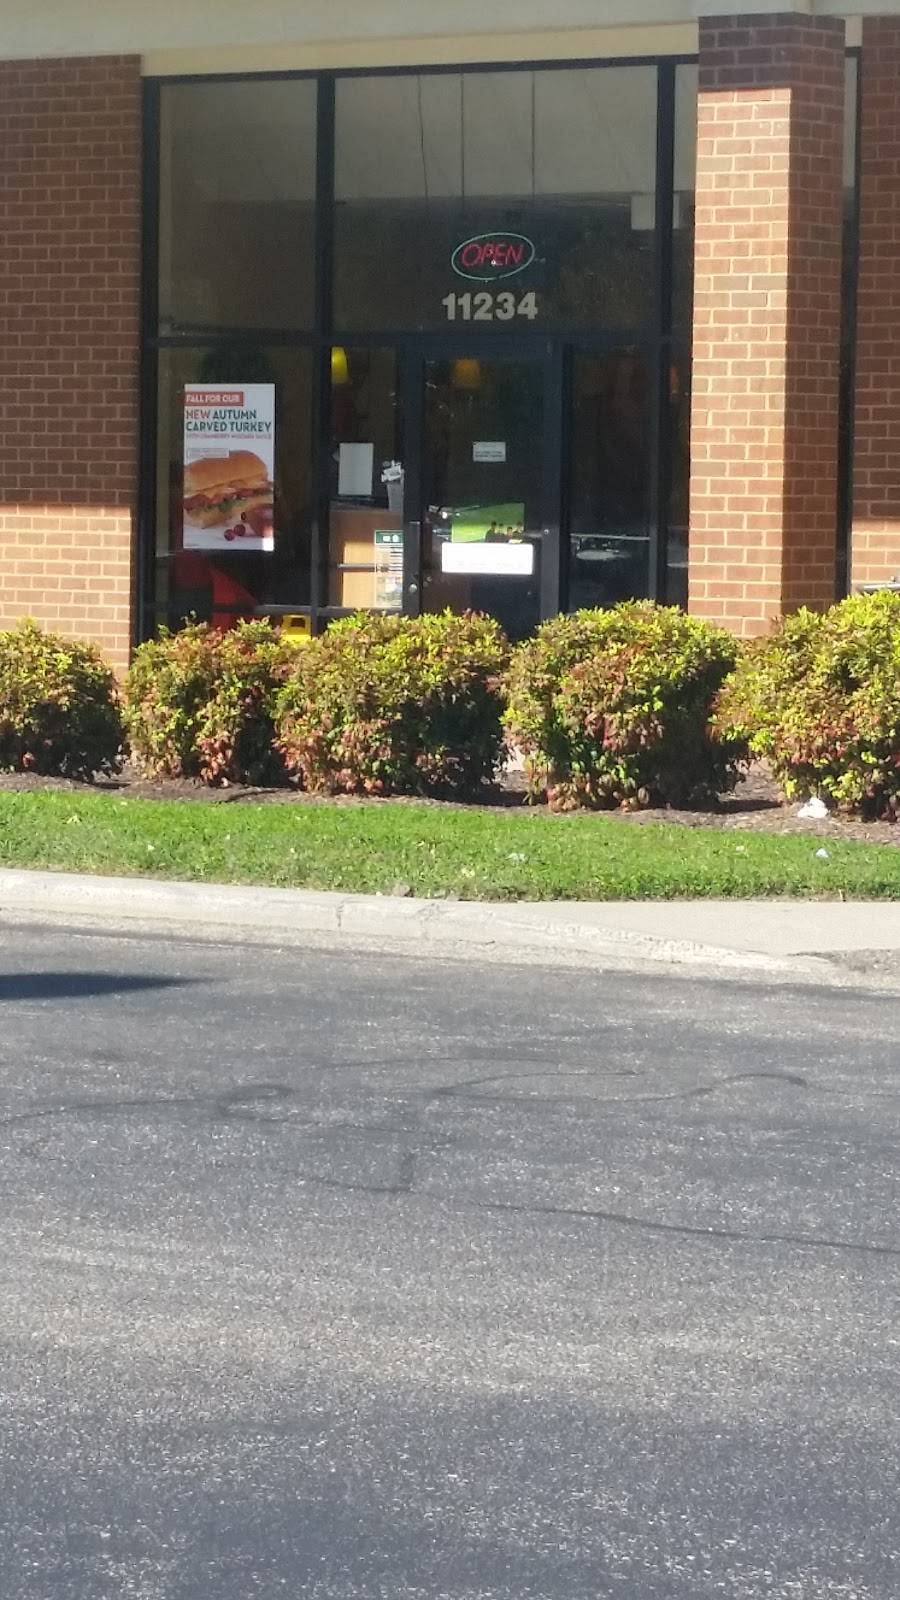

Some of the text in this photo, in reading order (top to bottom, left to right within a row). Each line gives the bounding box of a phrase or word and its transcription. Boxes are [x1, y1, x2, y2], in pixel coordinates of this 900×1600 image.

[462, 243, 524, 268] OPEN
[442, 292, 538, 320] 11234
[186, 394, 240, 402] FALL FOR OUR
[186, 409, 257, 420] NEW AUTUMN
[186, 421, 272, 432] CARVED TURKEY
